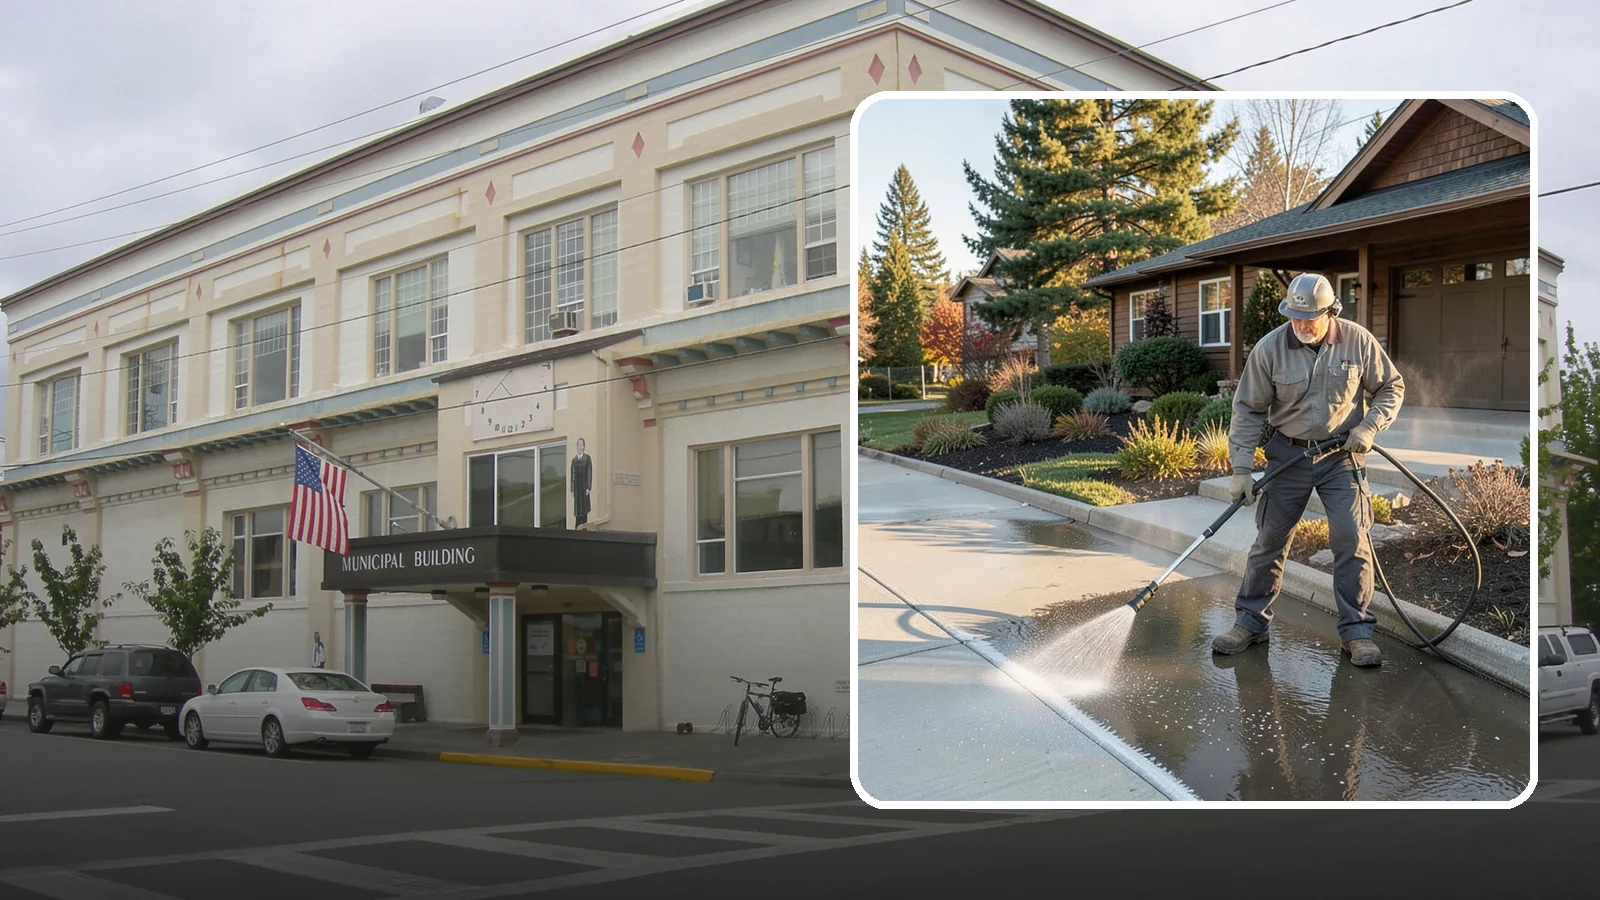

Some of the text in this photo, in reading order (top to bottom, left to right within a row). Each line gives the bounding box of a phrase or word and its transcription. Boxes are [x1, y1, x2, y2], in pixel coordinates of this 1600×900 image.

[536, 402, 540, 410] 4
[481, 407, 485, 415] 8
[488, 418, 492, 426] 9
[528, 414, 533, 422] 3
[342, 546, 475, 572] MUNICIPAL BUILDING
